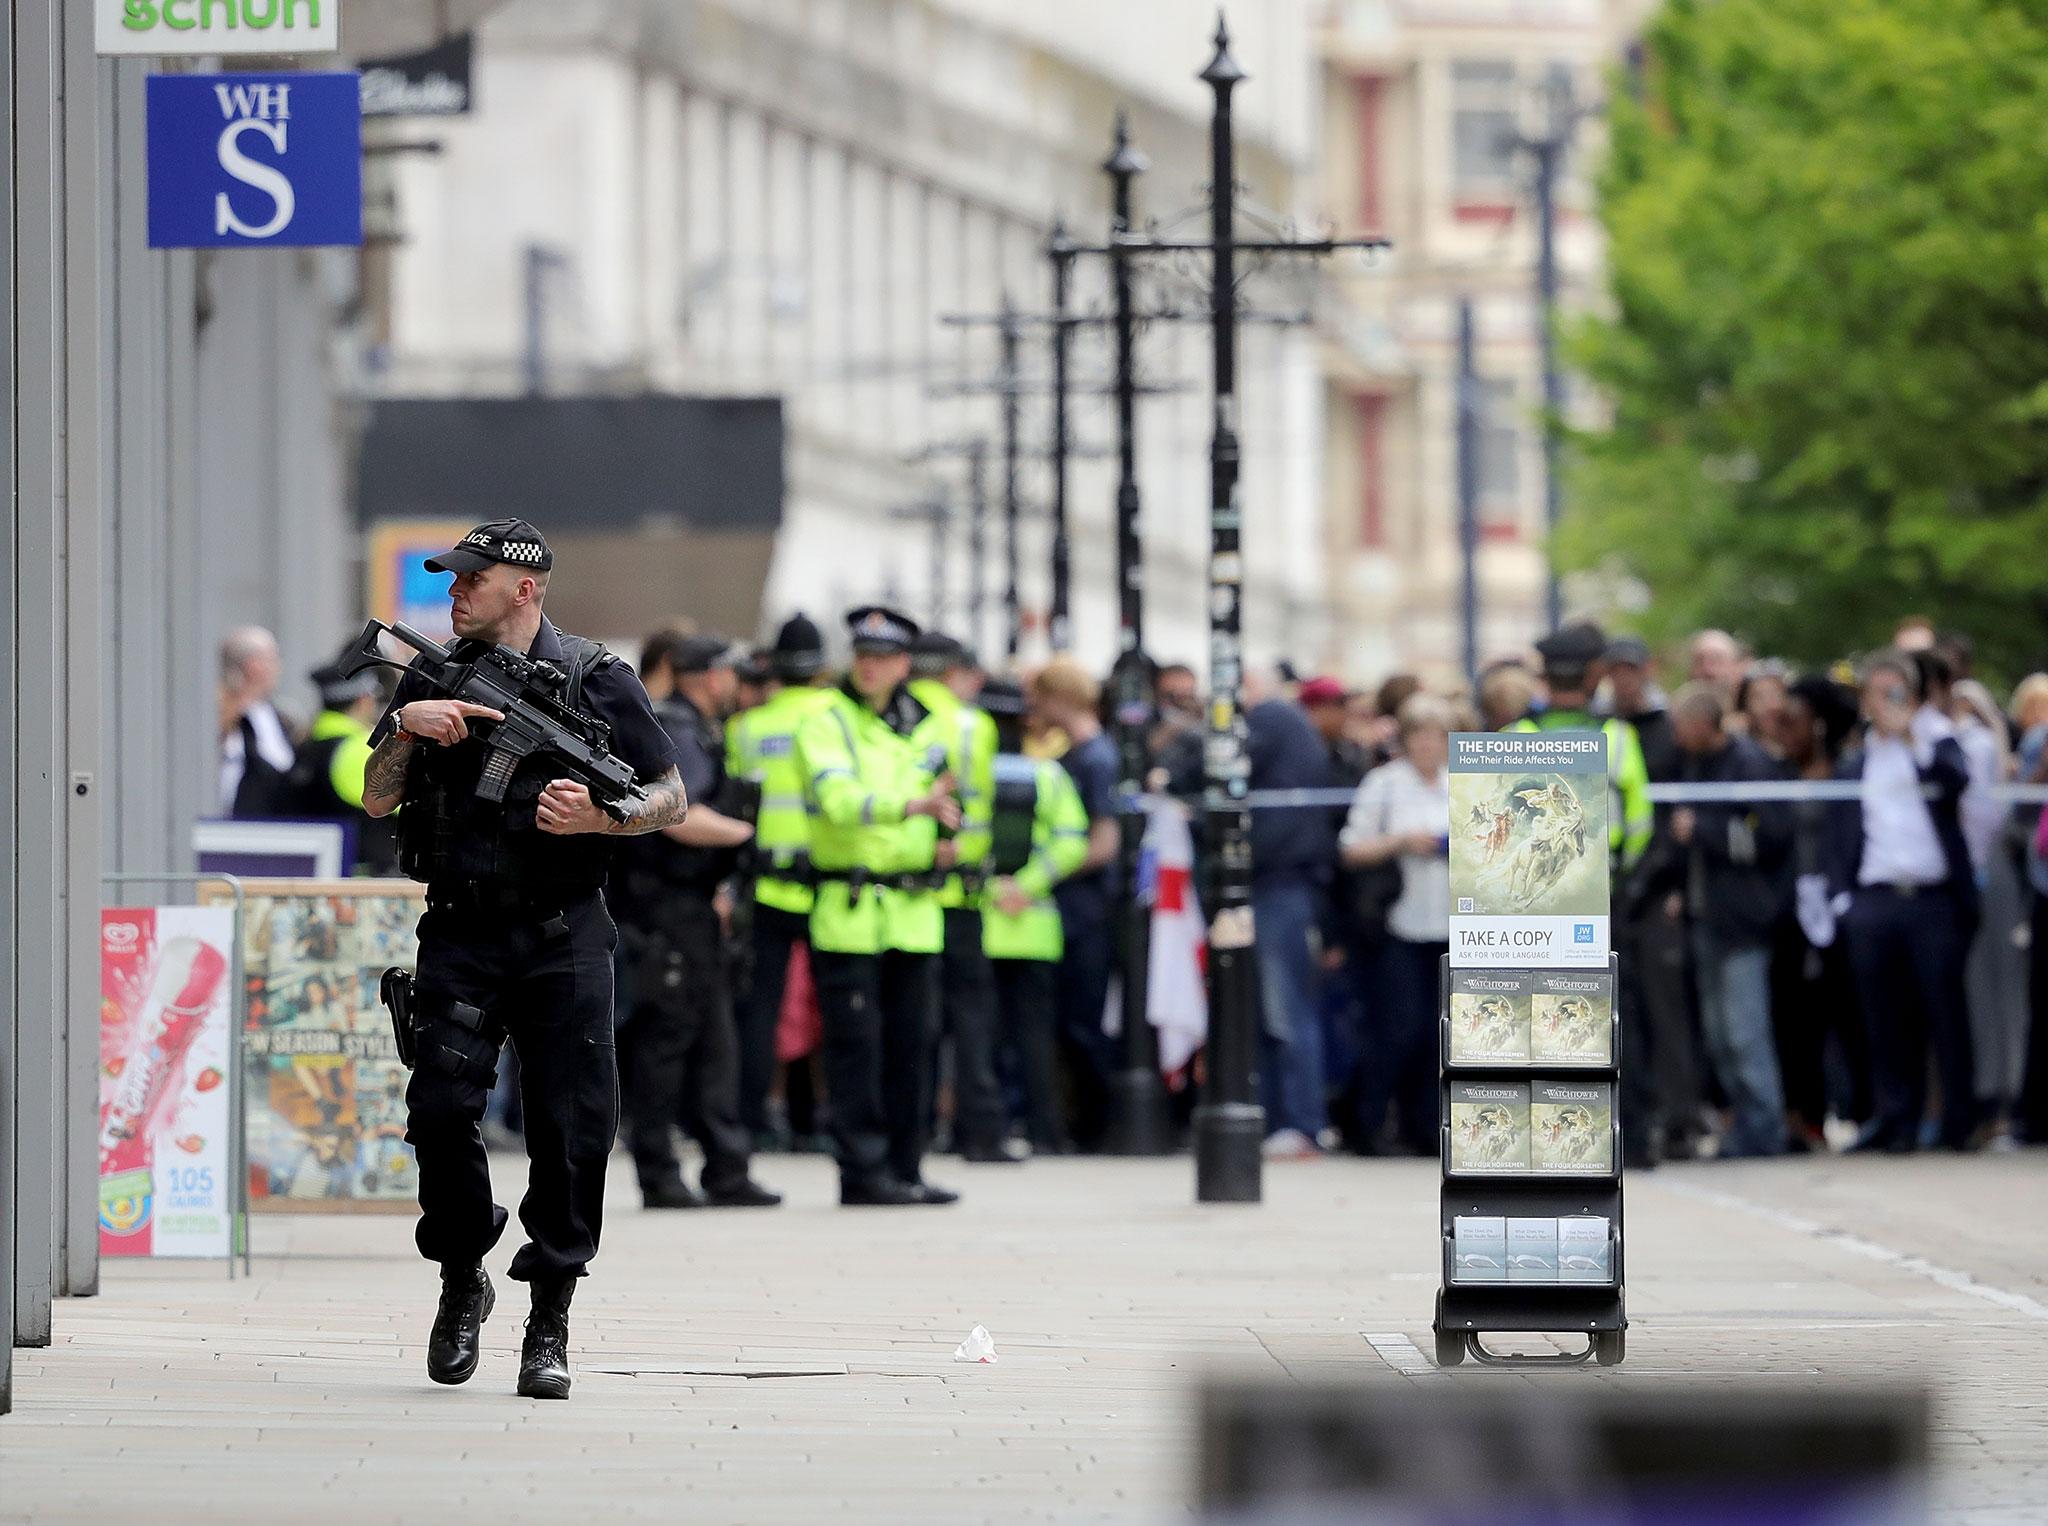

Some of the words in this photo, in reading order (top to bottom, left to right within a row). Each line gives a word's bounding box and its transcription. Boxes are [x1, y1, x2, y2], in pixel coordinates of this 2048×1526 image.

[213, 82, 292, 120] WH
[214, 117, 296, 239] S
[462, 532, 492, 548] ICE
[1458, 741, 1484, 753] THE
[1486, 741, 1523, 753] FOUR
[1526, 741, 1599, 753] HORSEMEN
[1459, 755, 1479, 764] How
[1480, 755, 1502, 764] Their
[1504, 755, 1523, 764] Ride
[1525, 755, 1556, 764] Affects
[1557, 755, 1574, 764] You
[1577, 927, 1591, 935] JW
[1459, 930, 1495, 946] TAKE
[1499, 930, 1510, 946] A
[1513, 930, 1553, 946] COPY
[1458, 951, 1473, 959] ASK
[1474, 951, 1489, 959] FOR
[1490, 951, 1510, 959] YOUR
[1512, 951, 1550, 959] LANGUAGE
[1467, 979, 1520, 989] WATCHTOWER
[1547, 979, 1600, 990] WATCHTOWER
[1465, 1088, 1519, 1097] WATCHTOWER
[1546, 1088, 1599, 1098] WATCHTOWER
[167, 1167, 214, 1193] 105
